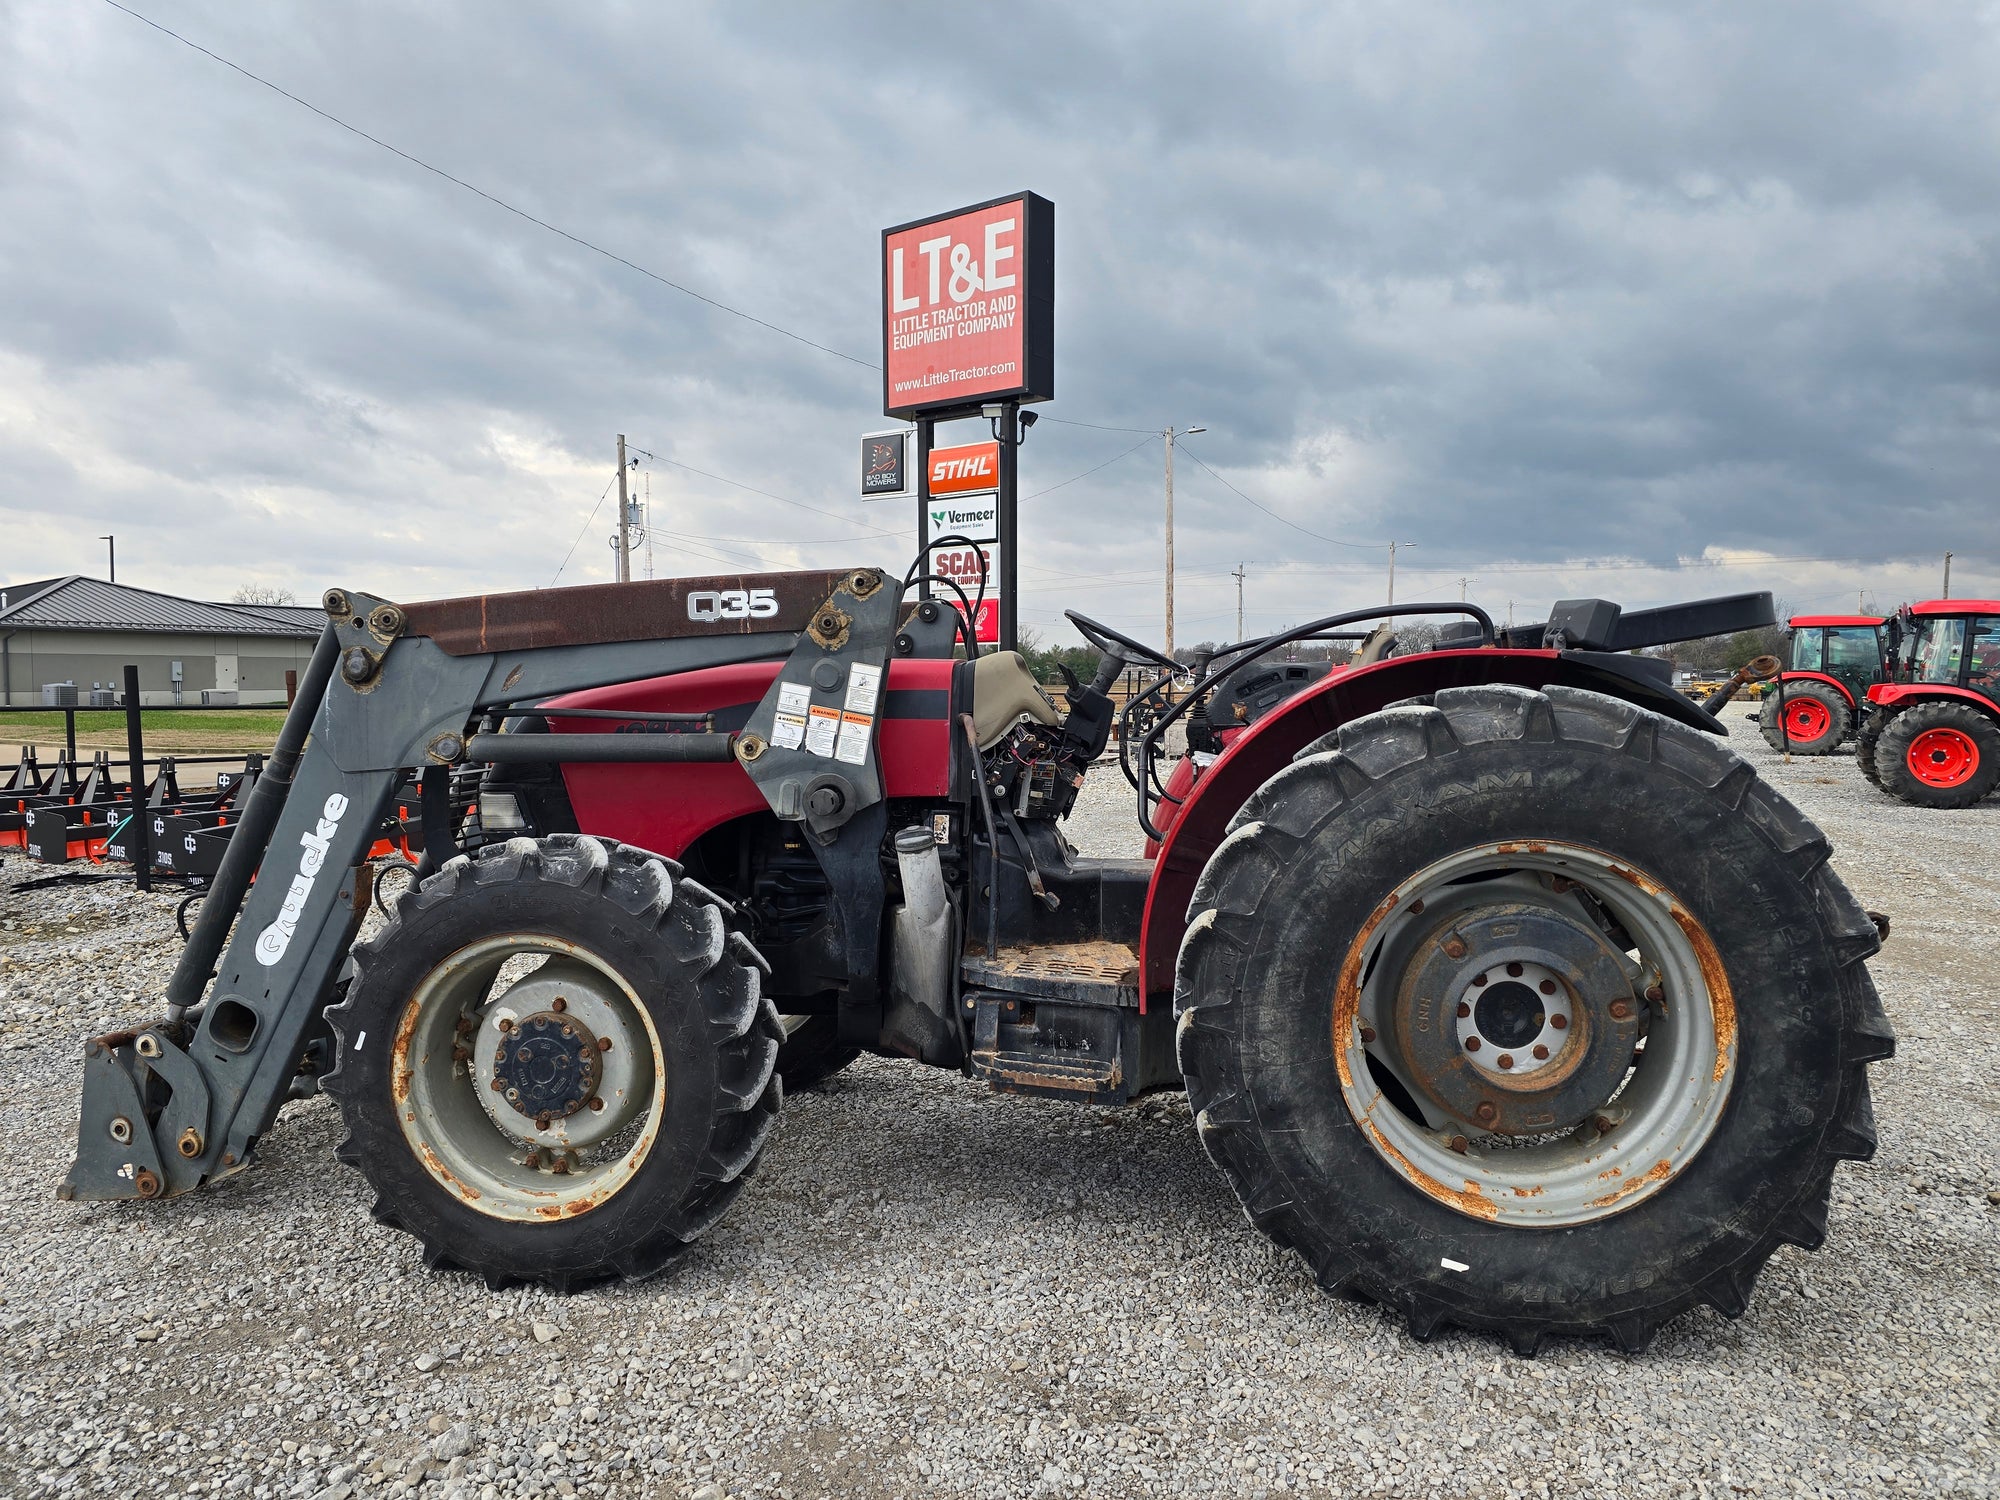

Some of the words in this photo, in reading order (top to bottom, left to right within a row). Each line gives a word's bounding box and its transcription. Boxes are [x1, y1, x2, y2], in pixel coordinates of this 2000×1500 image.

[893, 217, 1016, 314] LT&E
[893, 313, 929, 335] LITTLE
[931, 301, 986, 325] TRACTOR
[989, 295, 1016, 314] AND
[893, 324, 954, 351] EQUIPMENT
[957, 312, 1016, 336] COMPANY
[894, 361, 1016, 393] www.LittleTractor.com
[866, 473, 880, 481] BAD
[932, 456, 991, 481] STIHL
[866, 478, 897, 487] MOWERS
[948, 510, 995, 524] Vermeer
[688, 587, 779, 623] Q35
[28, 843, 41, 857] 310S
[109, 844, 126, 858] 310S
[157, 850, 173, 865] 310S
[255, 793, 350, 967] Quicke
